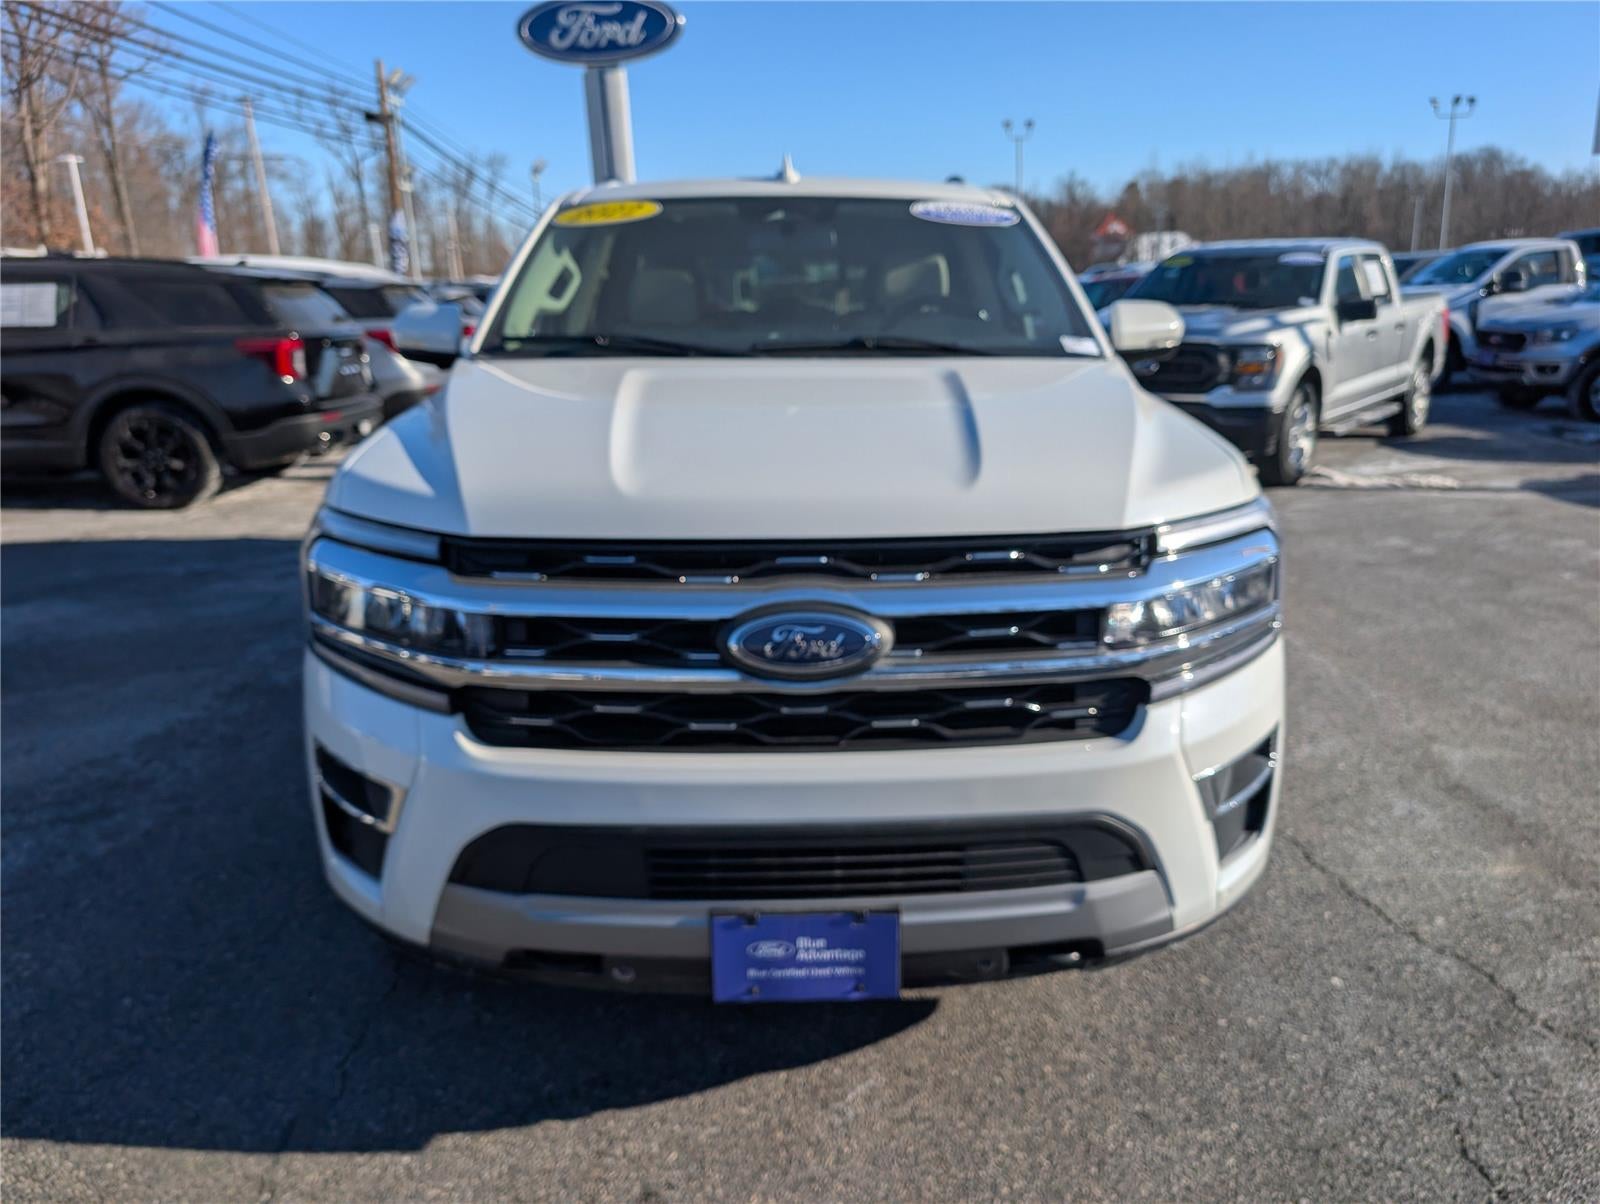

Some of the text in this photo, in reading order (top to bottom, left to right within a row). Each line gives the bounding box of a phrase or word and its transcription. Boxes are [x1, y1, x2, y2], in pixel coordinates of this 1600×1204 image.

[548, 2, 648, 50] Ford
[764, 624, 846, 659] Ford
[752, 941, 787, 958] Ford
[796, 936, 827, 949] Blue
[796, 948, 866, 962] Advantage
